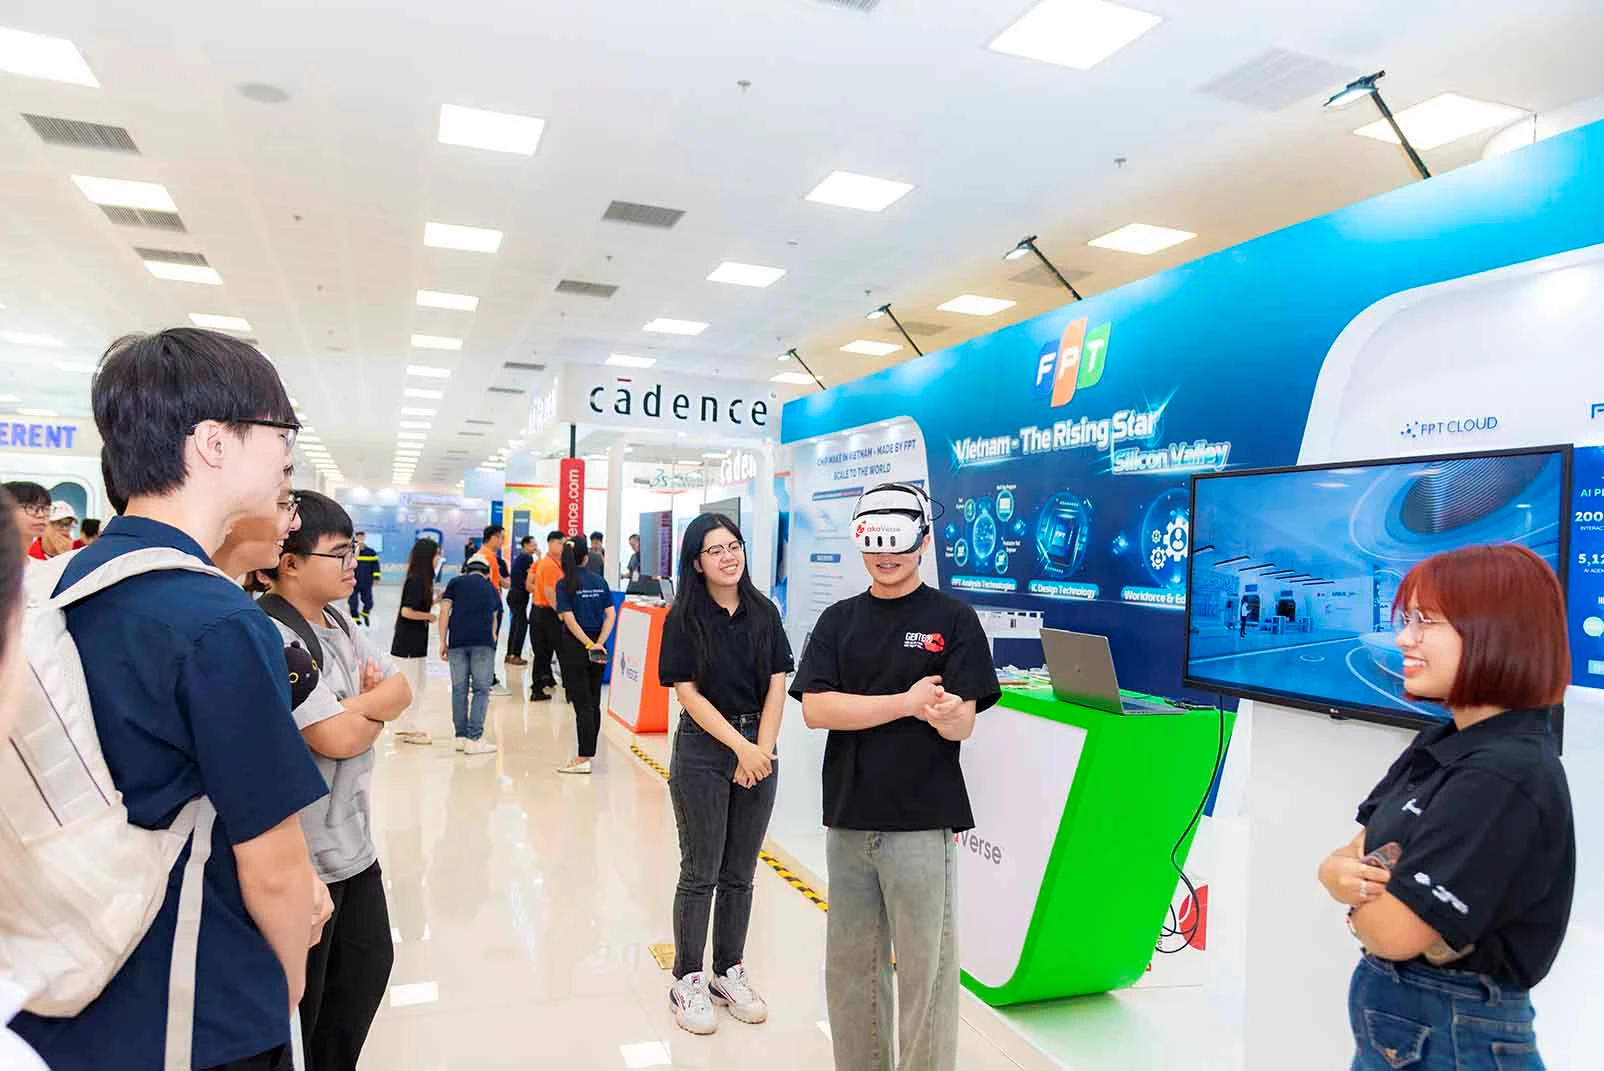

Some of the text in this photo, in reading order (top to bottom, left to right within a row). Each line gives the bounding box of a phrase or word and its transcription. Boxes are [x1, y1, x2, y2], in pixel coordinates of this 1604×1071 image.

[955, 435, 1011, 463] Vietnam
[1019, 425, 1051, 454] The
[1053, 415, 1110, 450] Rising
[1112, 409, 1159, 439] Star
[1420, 416, 1498, 436] FPT CLOUD
[877, 443, 894, 456] MADE
[903, 439, 916, 451] FPT
[1113, 440, 1231, 474] Silicon Valley
[869, 463, 891, 475] WORLD
[1580, 488, 1591, 497] AI
[568, 469, 580, 537] ence.com
